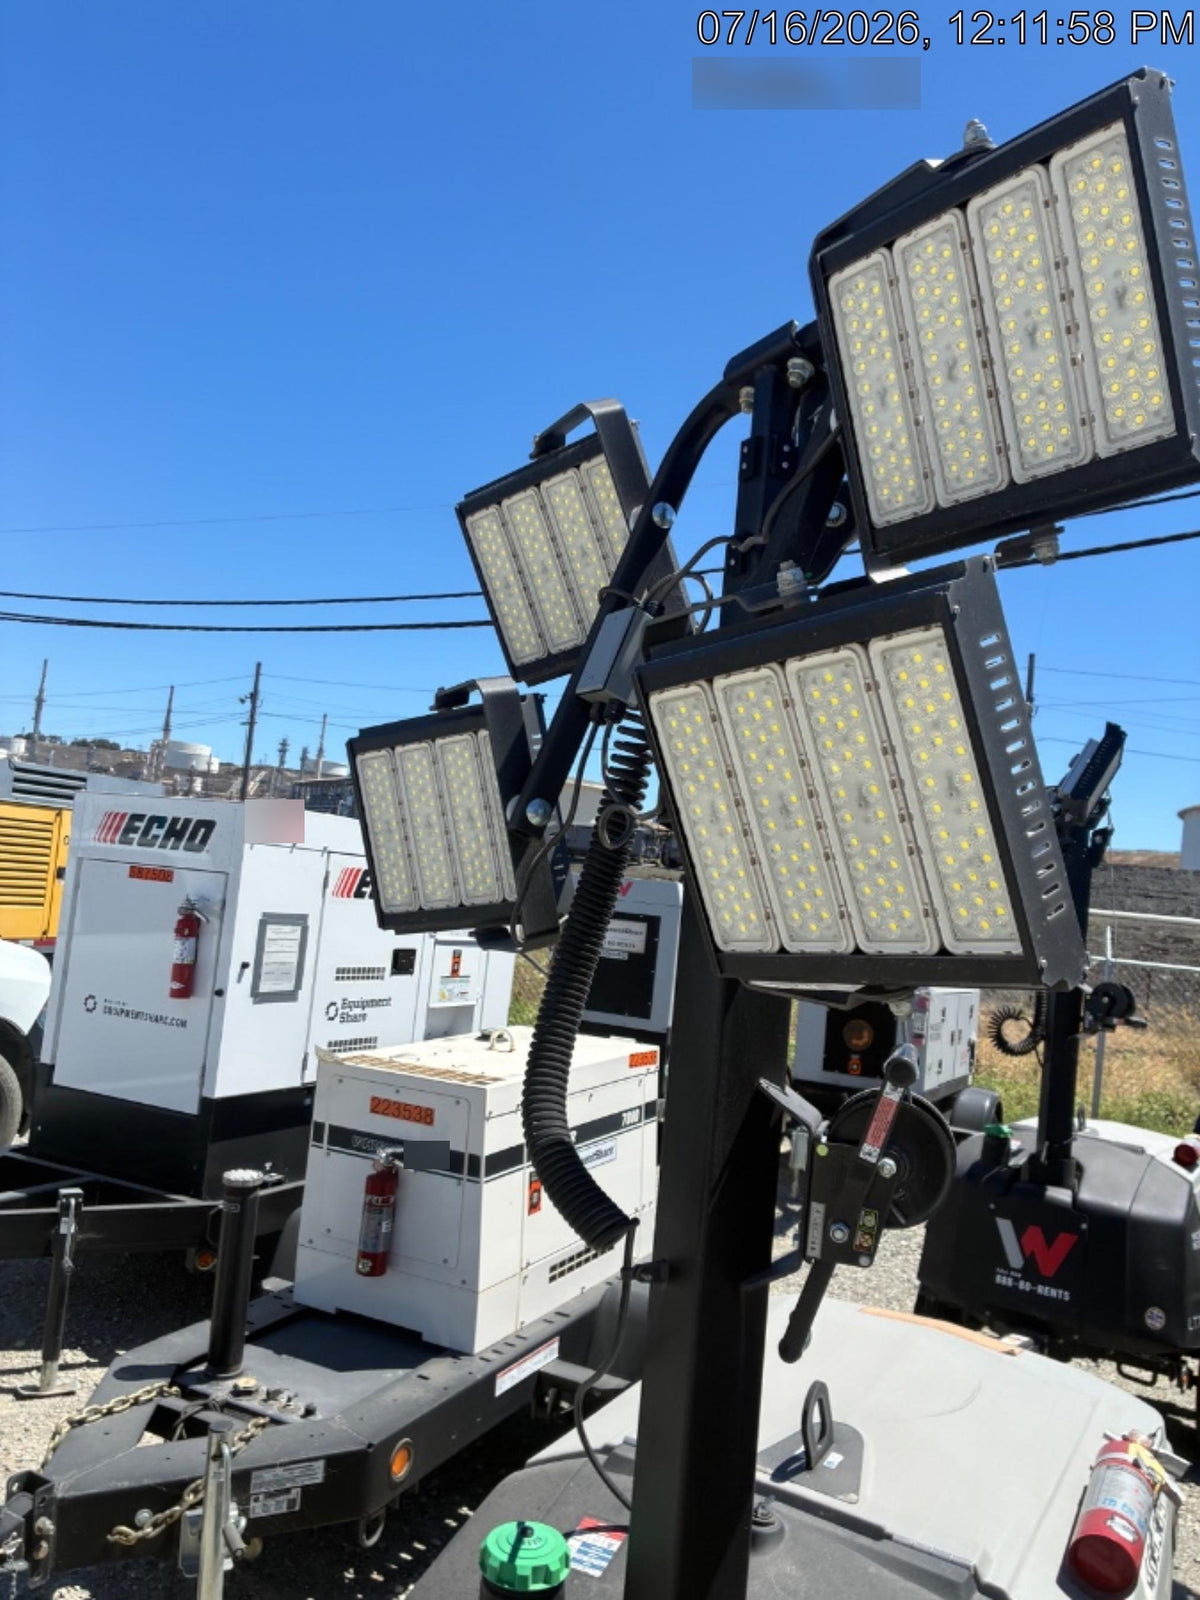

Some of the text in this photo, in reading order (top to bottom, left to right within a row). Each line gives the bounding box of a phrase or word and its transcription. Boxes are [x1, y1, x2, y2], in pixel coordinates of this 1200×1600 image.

[118, 813, 217, 853] ECHO
[341, 997, 392, 1012] Equipment
[339, 1011, 367, 1023] Share
[369, 1096, 435, 1126] 223538
